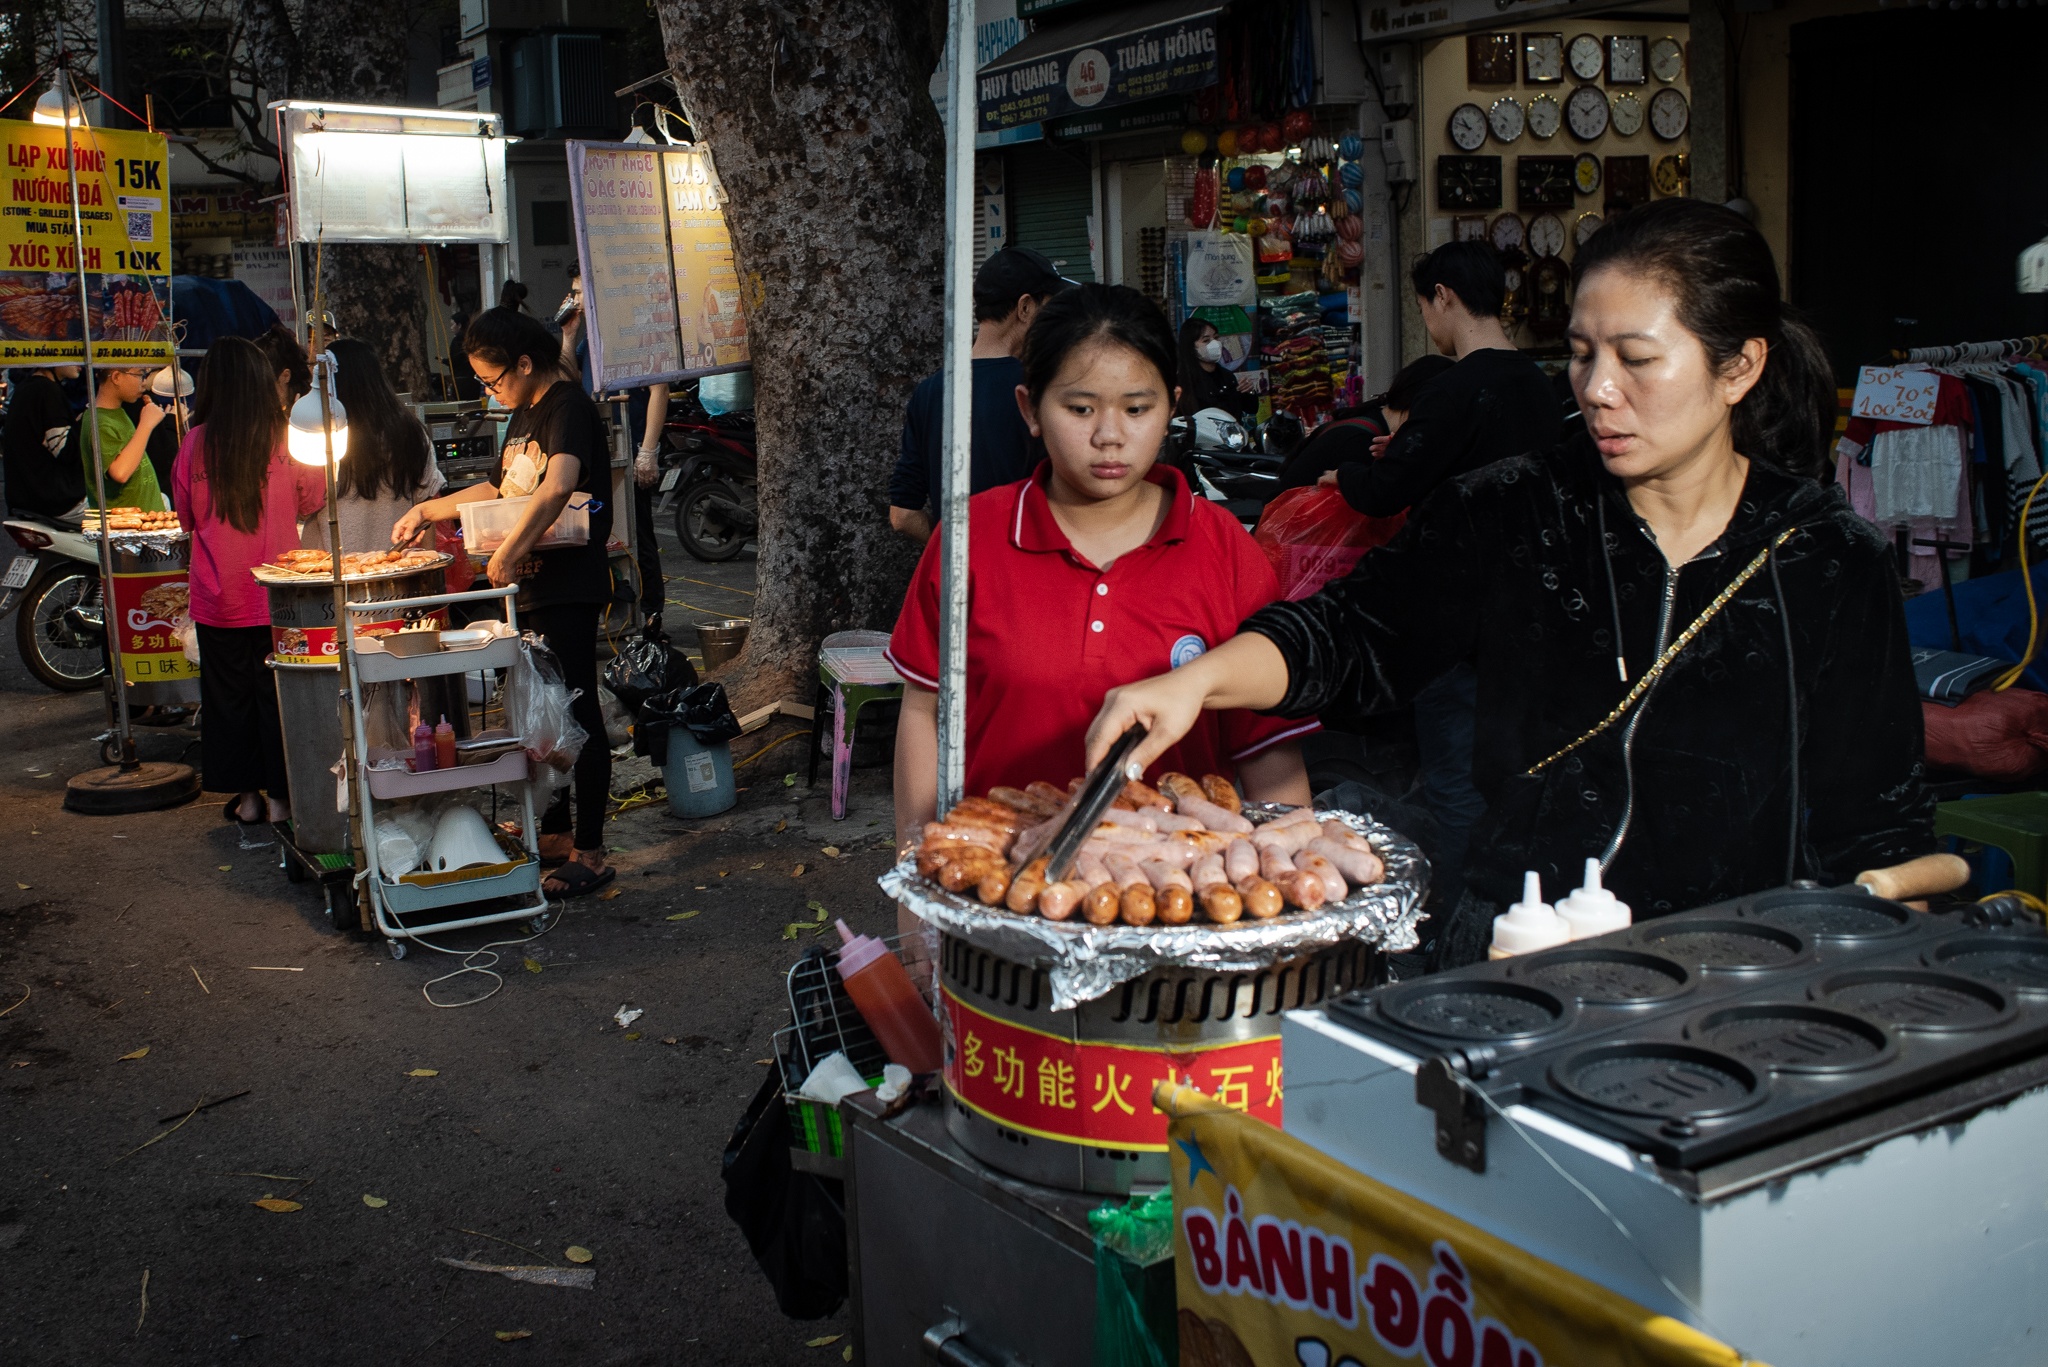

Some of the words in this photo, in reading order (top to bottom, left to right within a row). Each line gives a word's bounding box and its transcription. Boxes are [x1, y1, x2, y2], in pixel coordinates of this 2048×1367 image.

[1116, 34, 1160, 71] TUẤN
[1164, 25, 1217, 58] HỒNG
[981, 73, 1008, 101] HUY
[1011, 61, 1060, 97] QUANG
[1080, 59, 1095, 83] 46
[8, 143, 41, 173] LẠP
[115, 158, 162, 190] 15K
[13, 176, 71, 204] NƯỚNG
[26, 221, 48, 234] MUA
[8, 239, 50, 268] XÚC
[114, 250, 162, 271] 10K
[1860, 368, 1904, 385] 50K
[1894, 385, 1935, 401] 70K
